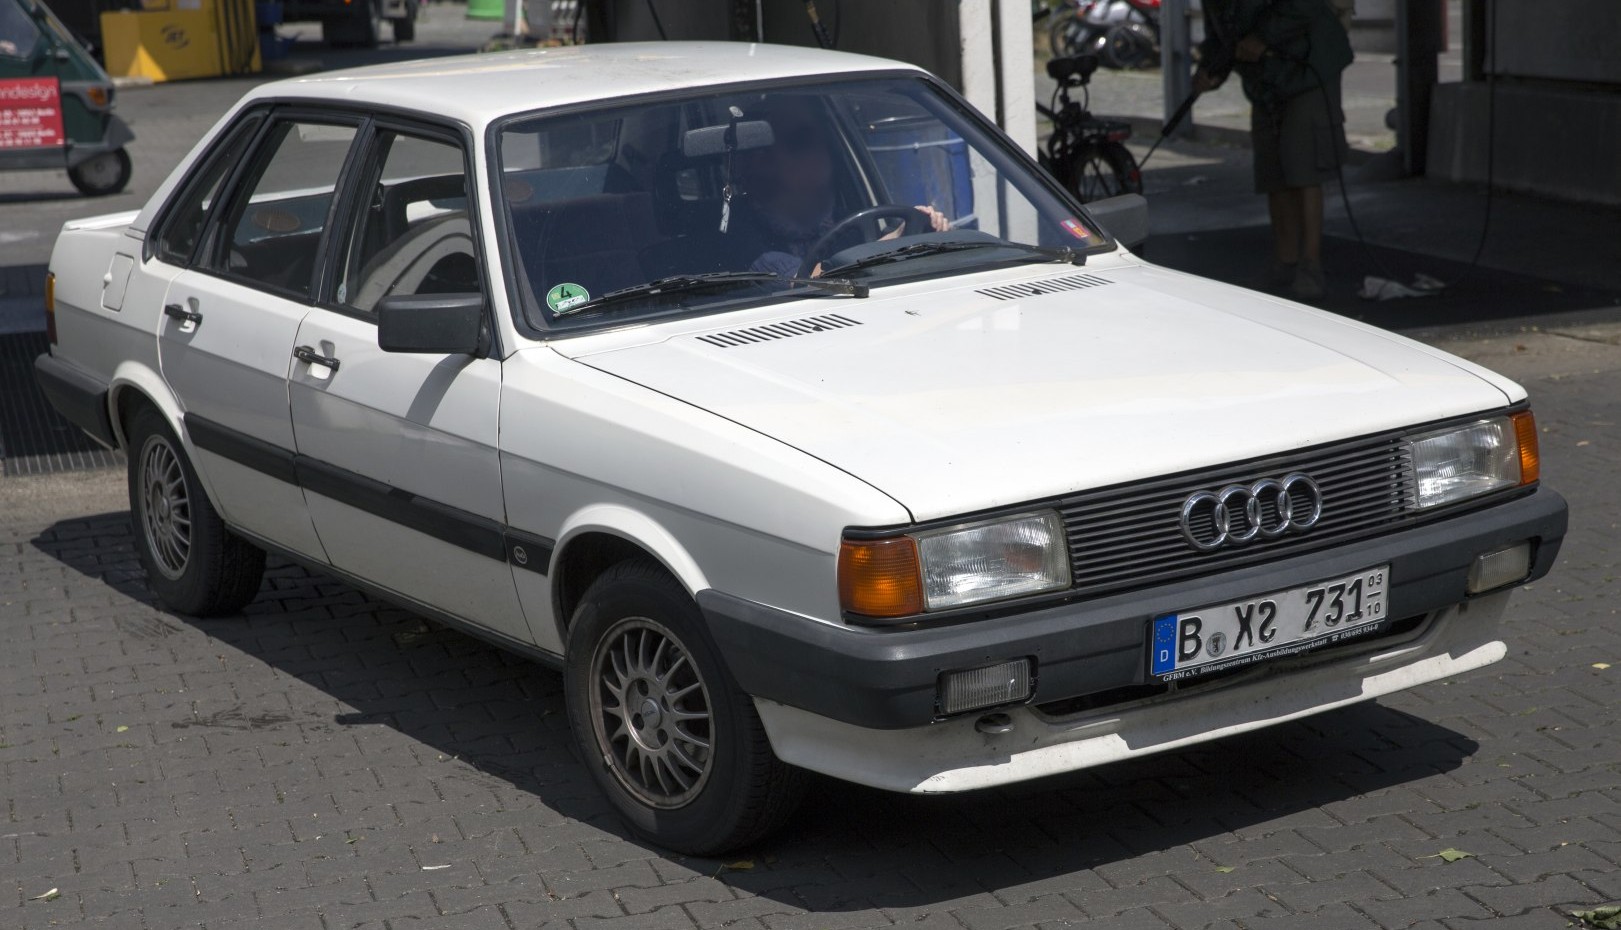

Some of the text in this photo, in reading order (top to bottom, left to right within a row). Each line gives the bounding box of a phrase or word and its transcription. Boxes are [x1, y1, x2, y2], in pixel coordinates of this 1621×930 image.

[0, 83, 57, 102] ndesign
[560, 286, 572, 299] 4
[1367, 572, 1383, 588] 03
[1366, 602, 1381, 616] 10
[1178, 616, 1203, 662] B
[1304, 577, 1363, 632] 731
[1160, 649, 1169, 662] D
[1163, 671, 1185, 682] GFBM
[1200, 657, 1251, 674] Bildungszentrum
[1252, 639, 1328, 662] Kfz-Ausbildungswerkstatt
